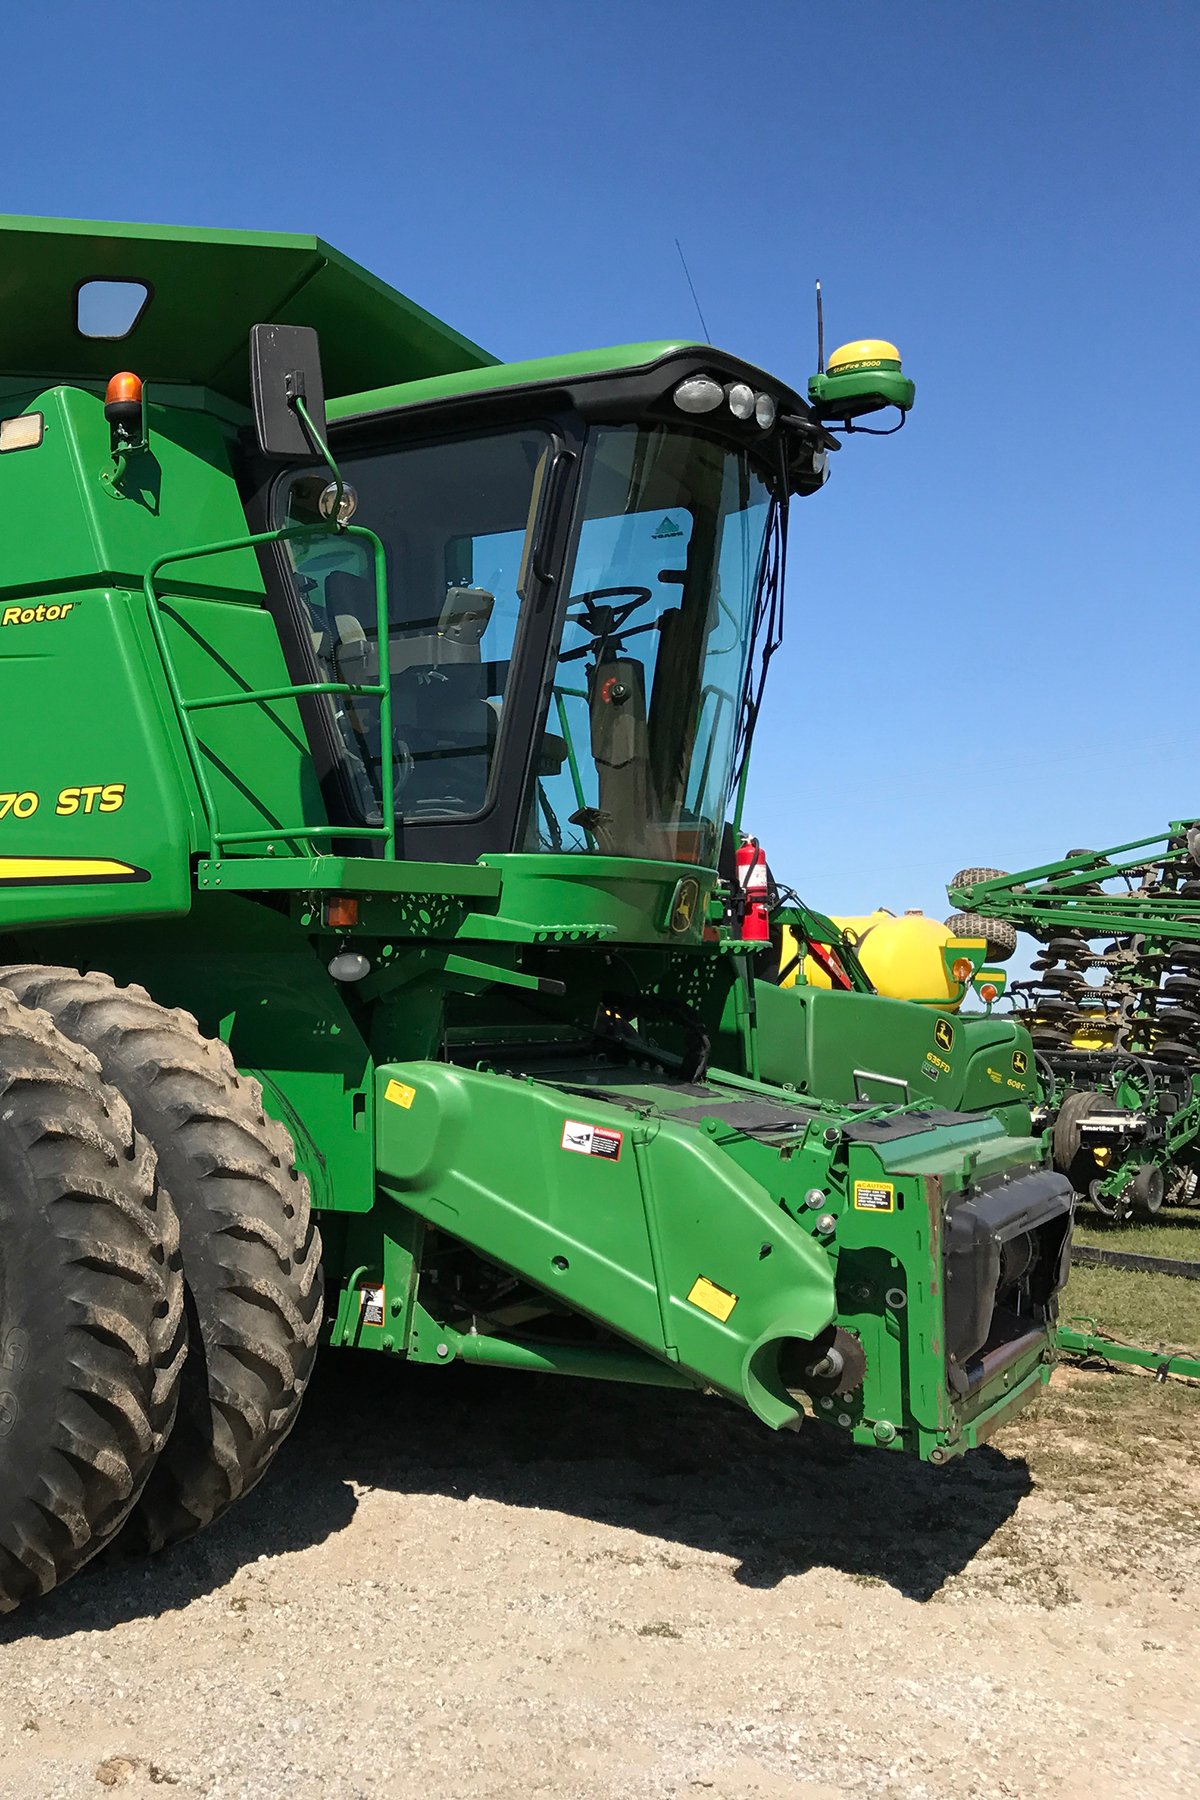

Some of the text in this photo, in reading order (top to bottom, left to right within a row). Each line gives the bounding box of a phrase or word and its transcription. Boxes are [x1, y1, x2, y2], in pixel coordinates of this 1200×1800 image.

[833, 363, 860, 374] StarFire
[55, 783, 126, 816] STS
[599, 1129, 622, 1139] DANGER
